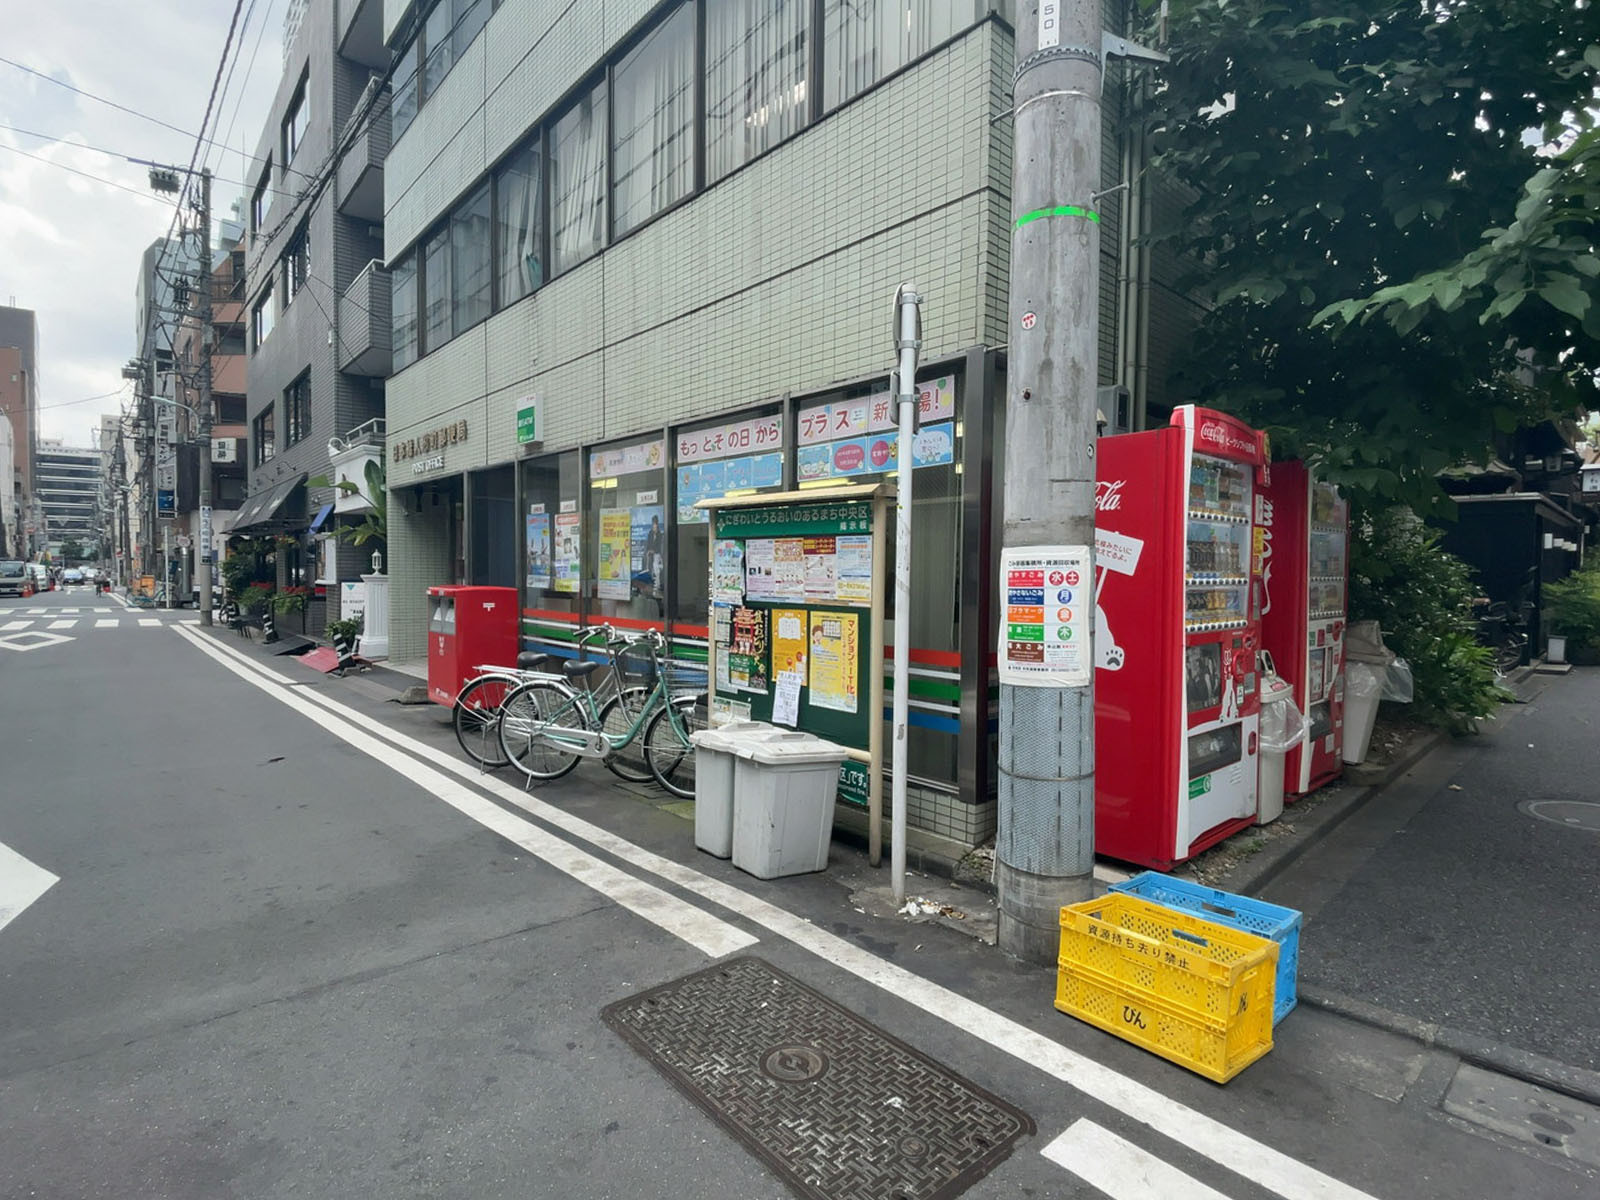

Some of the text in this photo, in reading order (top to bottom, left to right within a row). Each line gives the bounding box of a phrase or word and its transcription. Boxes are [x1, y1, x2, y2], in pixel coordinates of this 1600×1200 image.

[801, 388, 942, 437] プラス 新場!
[680, 422, 780, 456] もっとその日から
[1095, 480, 1127, 511] ola
[1051, 572, 1077, 583] 水 土
[1060, 590, 1070, 601] 月
[1060, 627, 1070, 638] 木
[1088, 923, 1191, 970] 資源持ち去り禁止
[1123, 1005, 1147, 1030] びん
